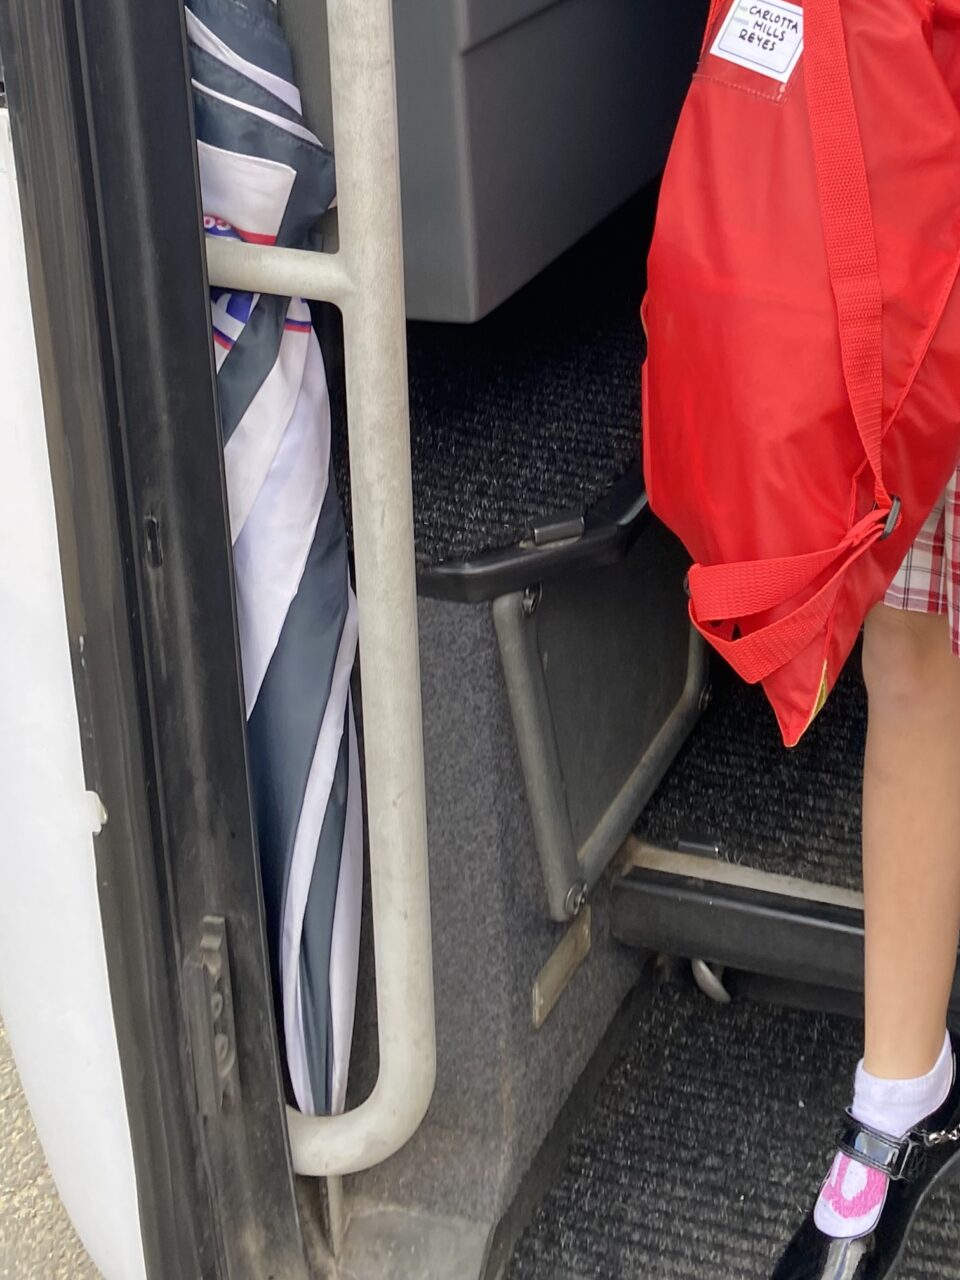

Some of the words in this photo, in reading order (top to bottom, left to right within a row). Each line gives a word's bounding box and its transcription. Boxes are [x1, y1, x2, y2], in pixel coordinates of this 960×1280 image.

[749, 5, 798, 34] CARLOTTA
[753, 20, 786, 42] MILLS
[738, 28, 777, 51] REYES
